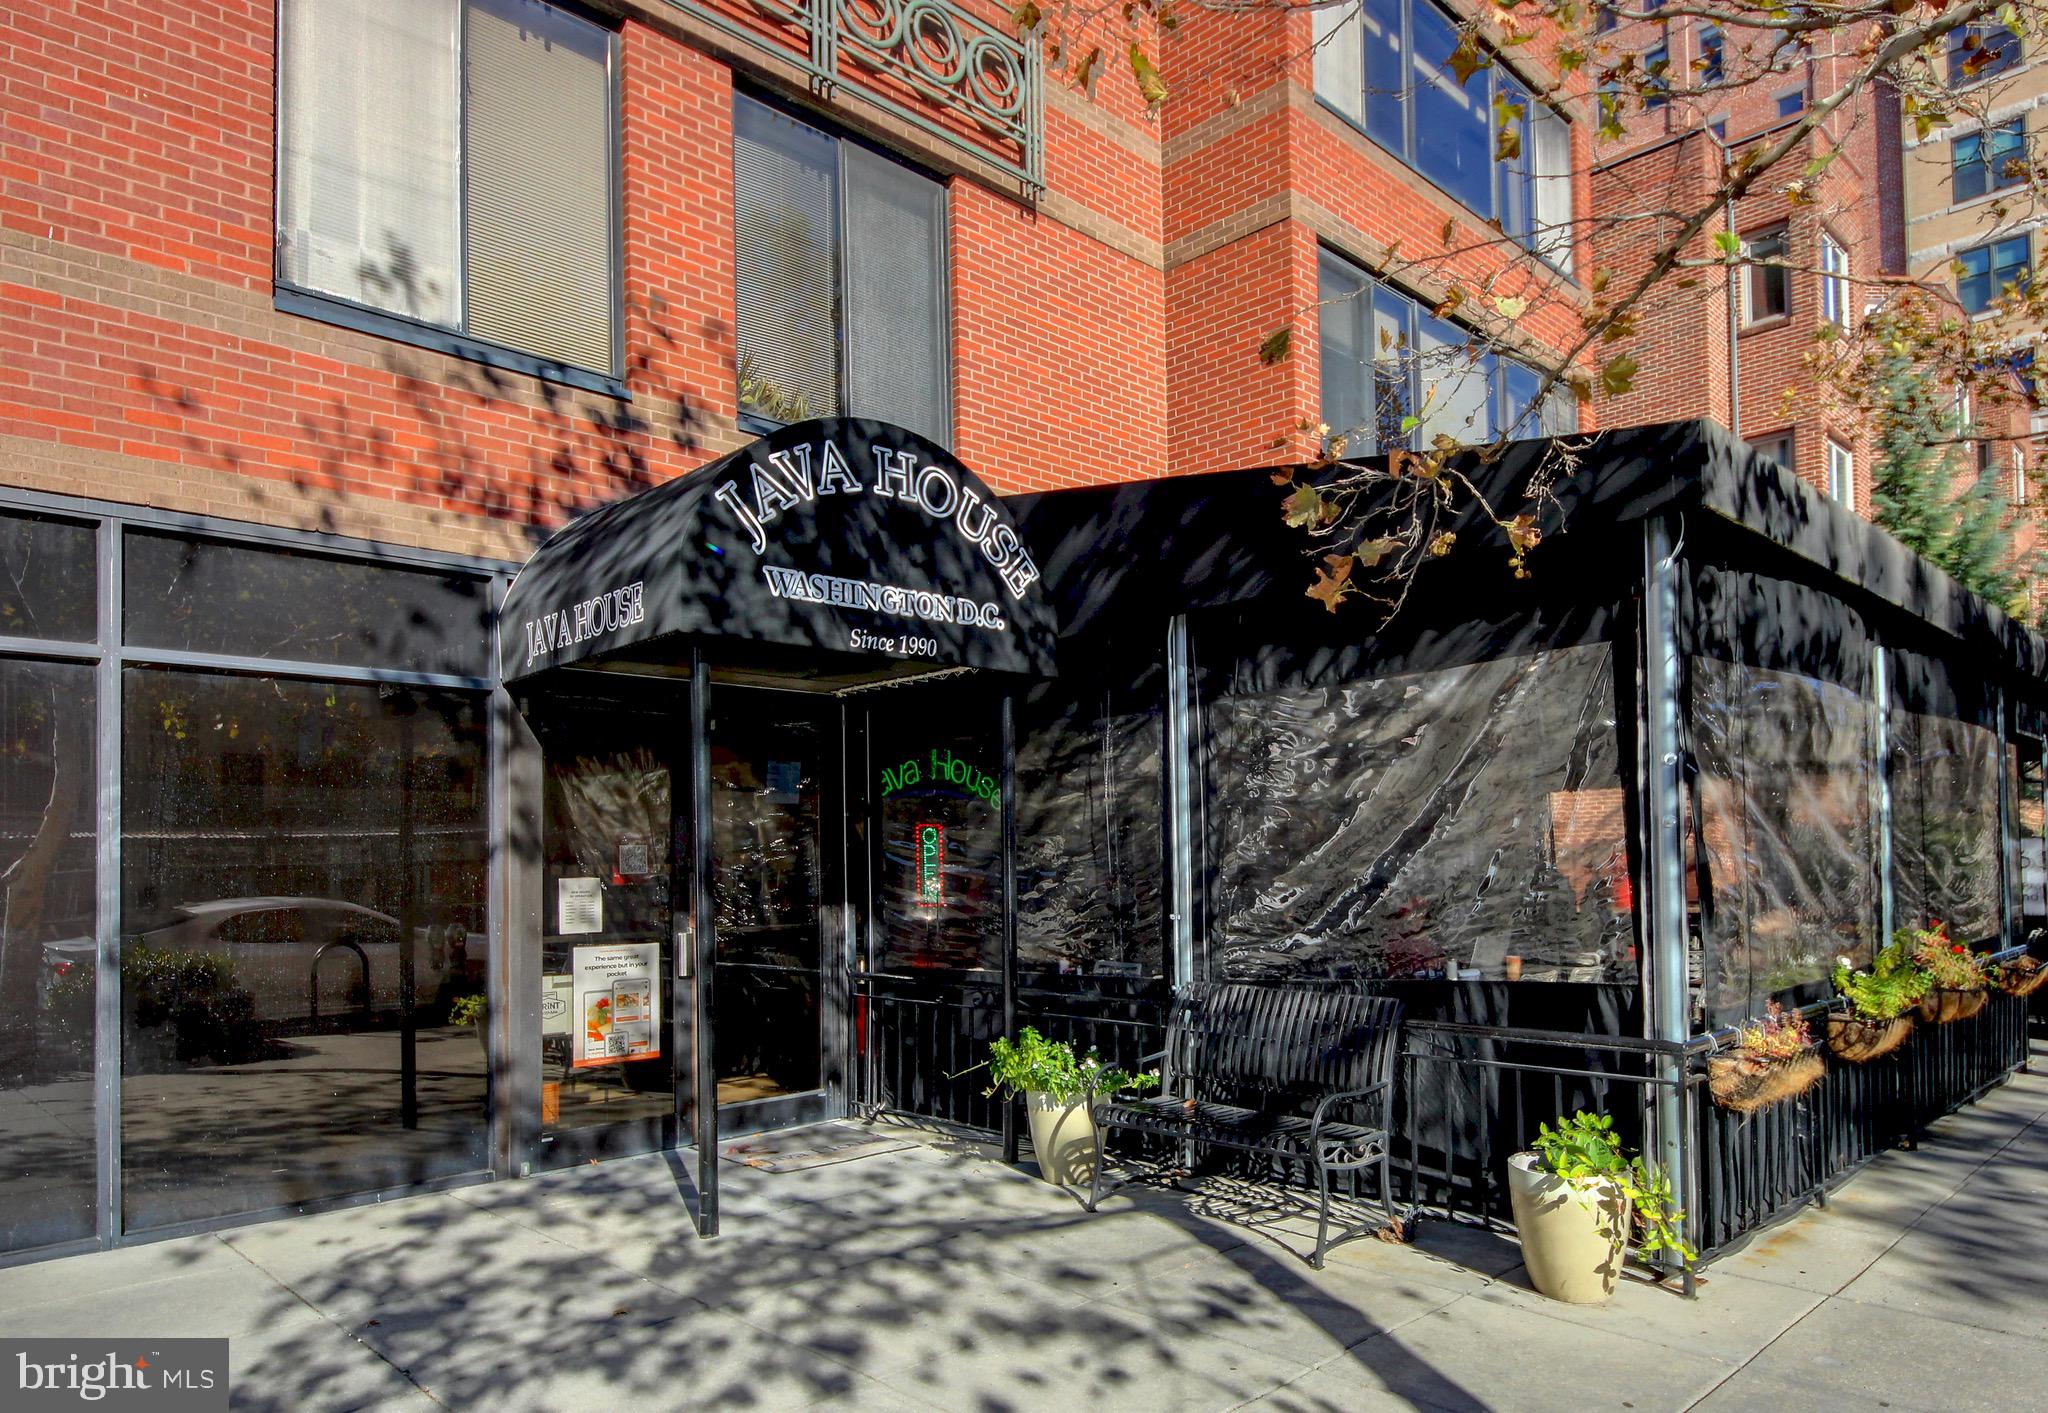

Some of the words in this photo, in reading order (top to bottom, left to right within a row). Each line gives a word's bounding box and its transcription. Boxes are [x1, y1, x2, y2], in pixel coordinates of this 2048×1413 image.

[714, 439, 864, 556] JAVA
[872, 445, 1040, 600] HOUSE
[526, 609, 573, 667] JAVA
[573, 581, 644, 643] HOUSE
[763, 565, 955, 623] WASHINGTON
[956, 597, 1005, 631] D.C.
[850, 628, 895, 652] Since
[898, 635, 938, 657] 1990
[881, 760, 920, 797] ava
[929, 749, 1001, 810] House
[543, 1001, 560, 1011] RiNT
